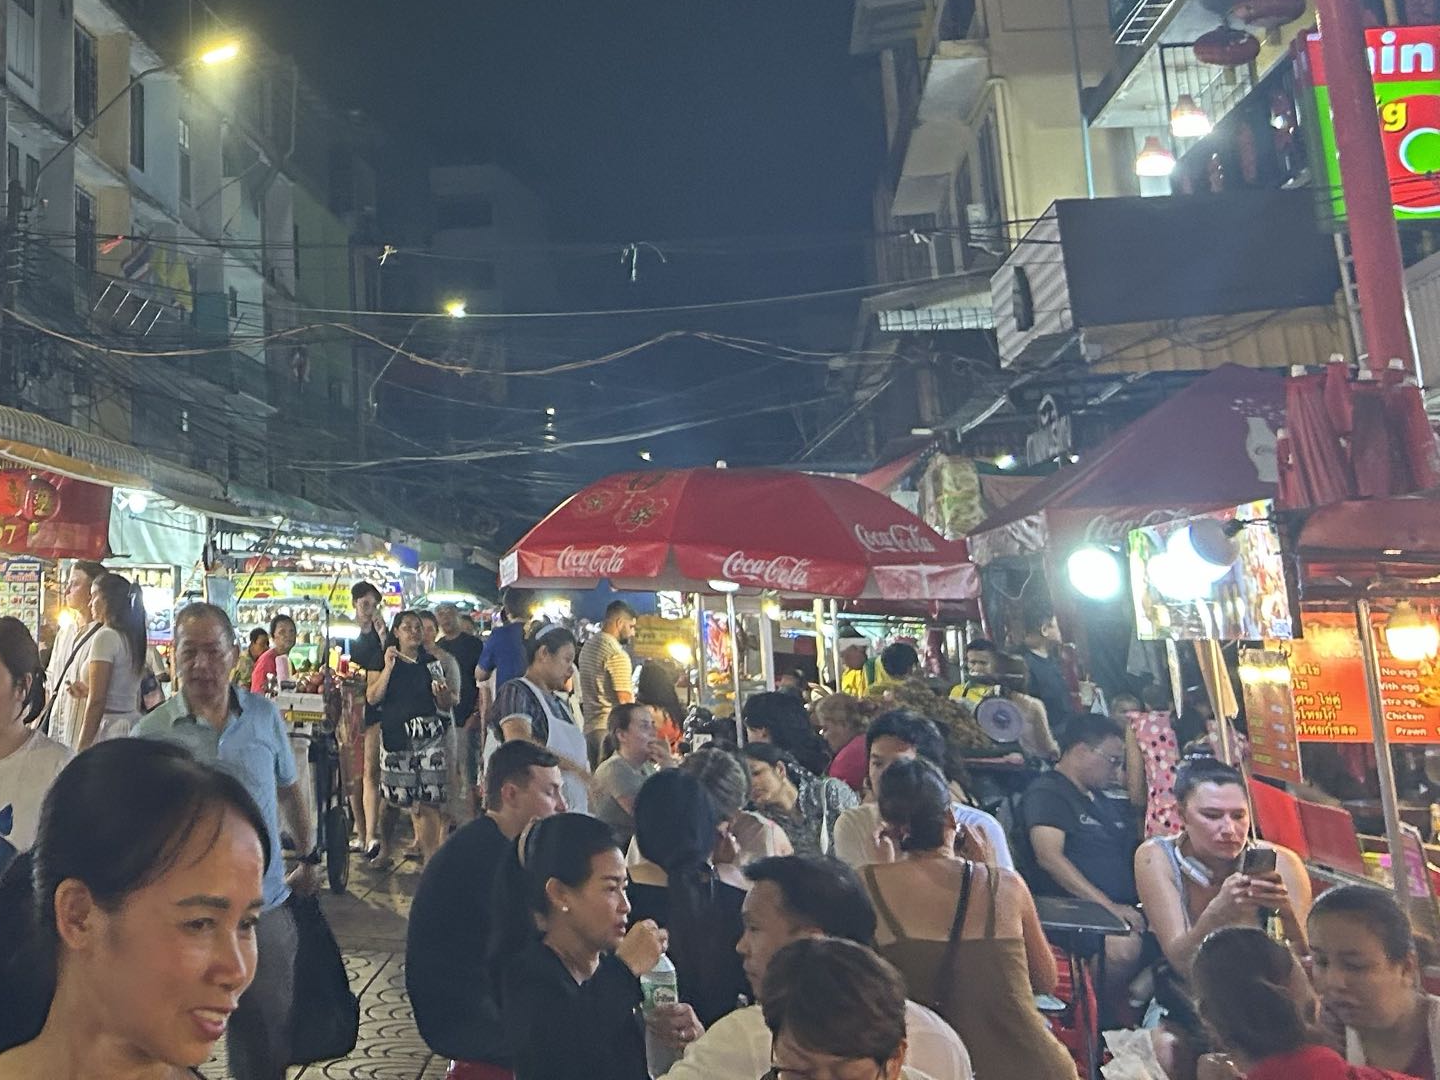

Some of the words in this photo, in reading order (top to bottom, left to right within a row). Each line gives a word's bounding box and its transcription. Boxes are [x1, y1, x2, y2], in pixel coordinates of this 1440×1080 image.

[1382, 698, 1400, 706] xtra
[1385, 711, 1425, 721] Chicken
[1395, 727, 1427, 736] Prawn
